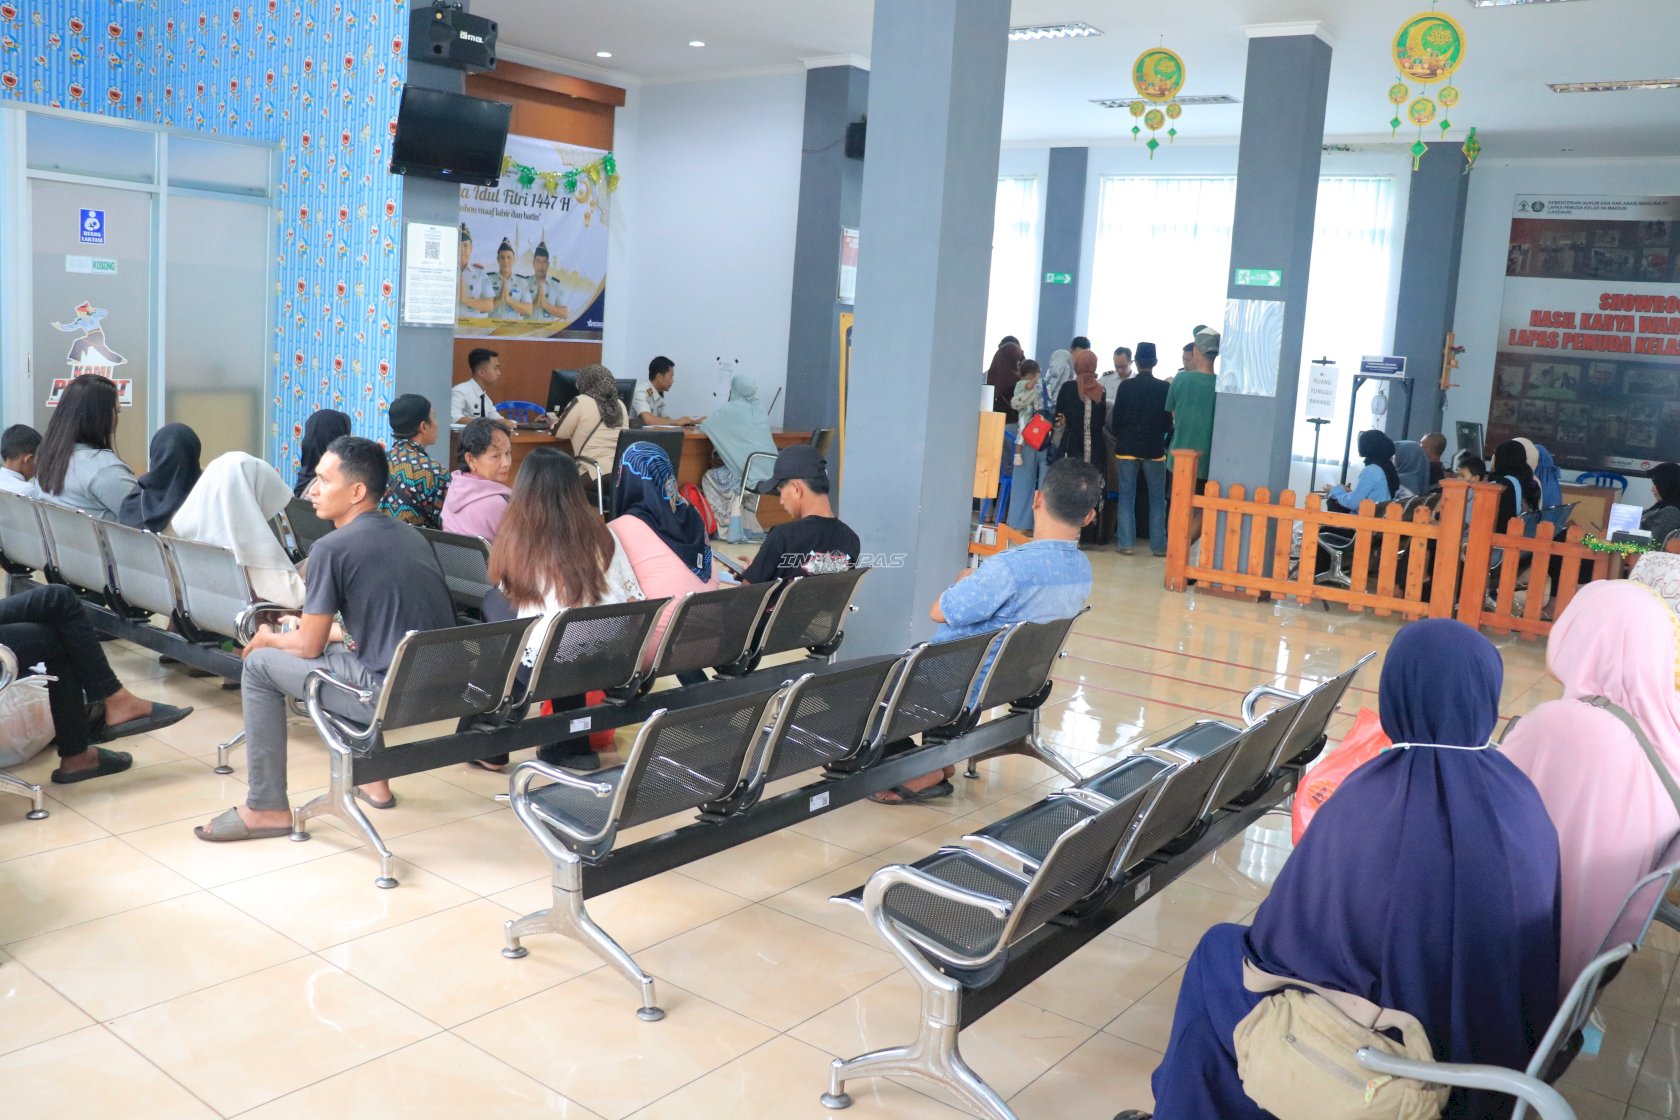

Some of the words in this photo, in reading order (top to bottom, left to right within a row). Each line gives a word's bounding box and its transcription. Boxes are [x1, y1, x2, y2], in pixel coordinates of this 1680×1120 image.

[473, 185, 500, 202] Idul
[503, 188, 529, 207] Fitri
[531, 193, 558, 210] 1447
[560, 196, 571, 211] H
[460, 203, 477, 214] ohon
[511, 209, 523, 219] dan
[92, 260, 115, 271] KOSONG
[1529, 310, 1576, 329] HASIL
[1579, 313, 1635, 333] KARYA
[1508, 329, 1559, 349] LAPAS
[1561, 332, 1632, 353] PEMUDA
[1634, 336, 1680, 356] KELA
